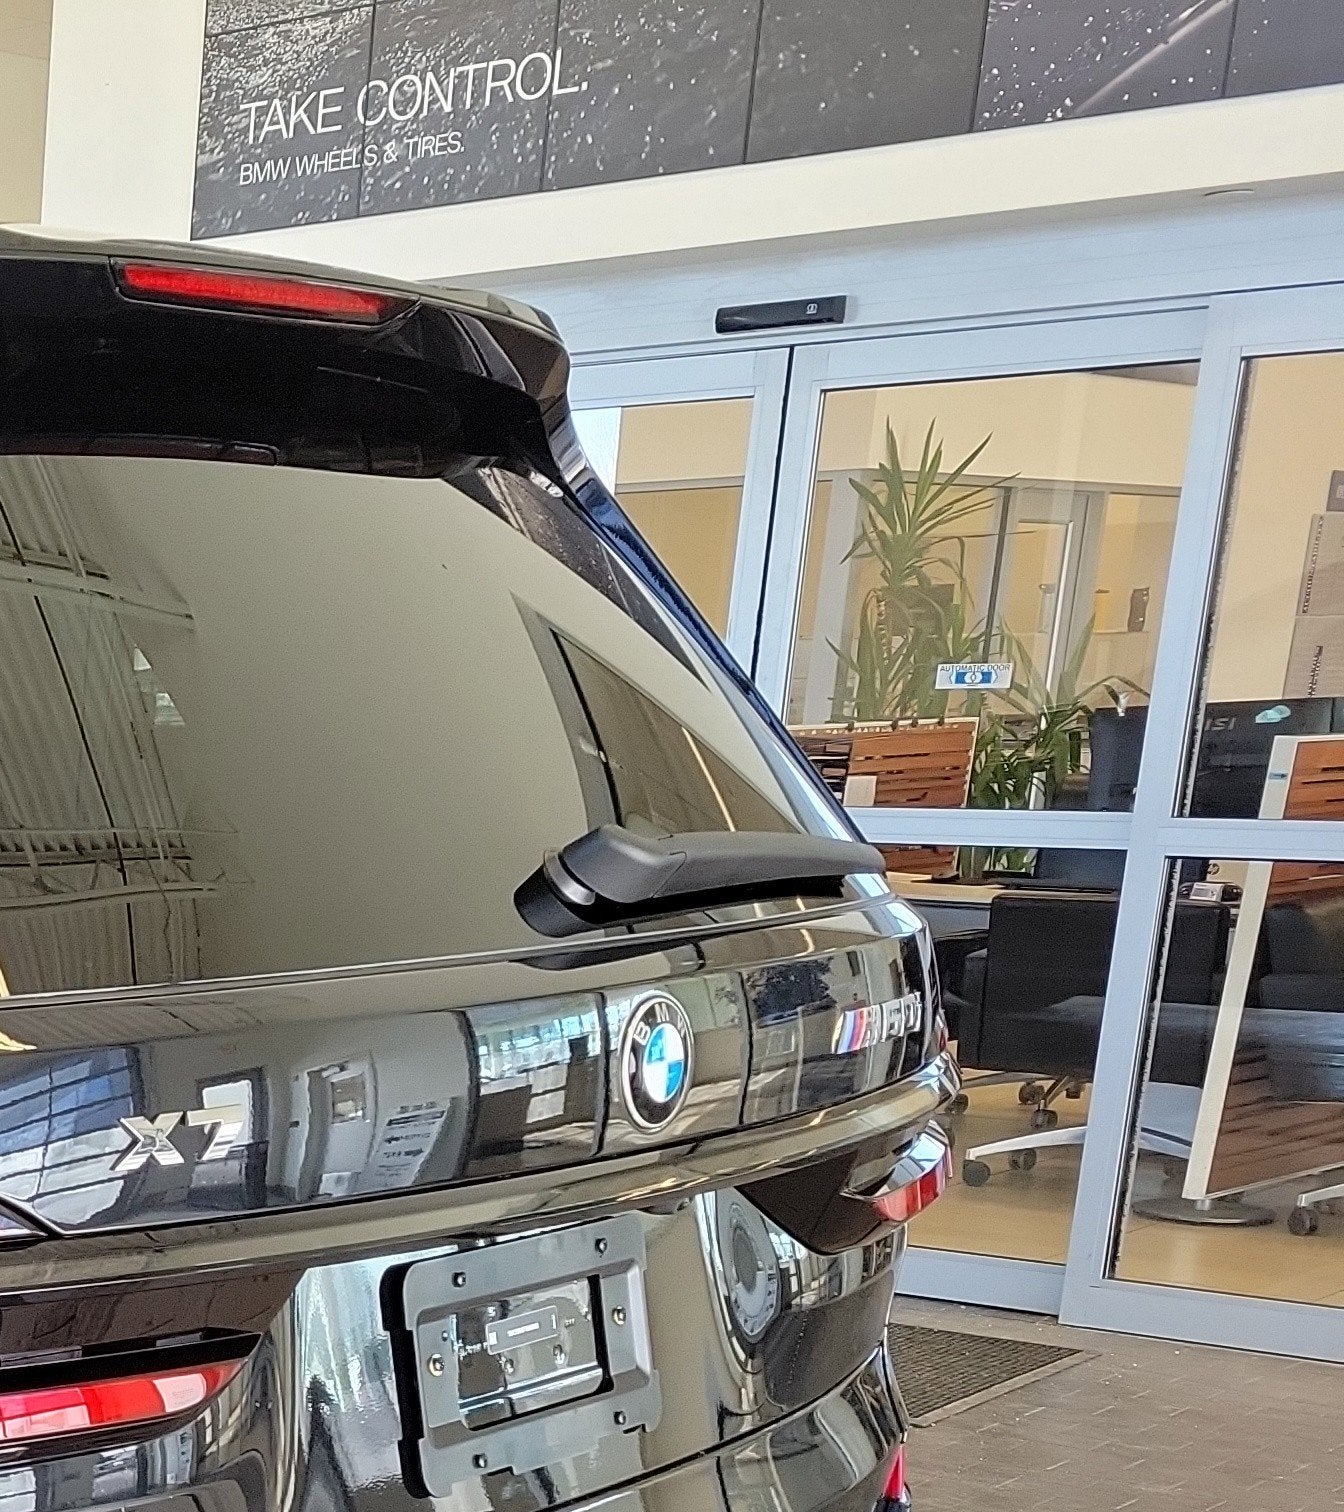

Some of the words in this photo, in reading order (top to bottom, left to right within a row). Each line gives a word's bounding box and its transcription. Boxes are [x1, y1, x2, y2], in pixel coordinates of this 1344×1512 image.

[238, 86, 345, 145] TAKE
[356, 48, 589, 126] CONTROL.
[238, 157, 291, 186] BMW
[295, 144, 379, 178] WHEELS
[383, 141, 399, 163] &
[404, 131, 465, 161] TIRES.
[939, 664, 986, 672] AUTOMATIC
[632, 1002, 688, 1046] BMW
[110, 1104, 245, 1172] X7
